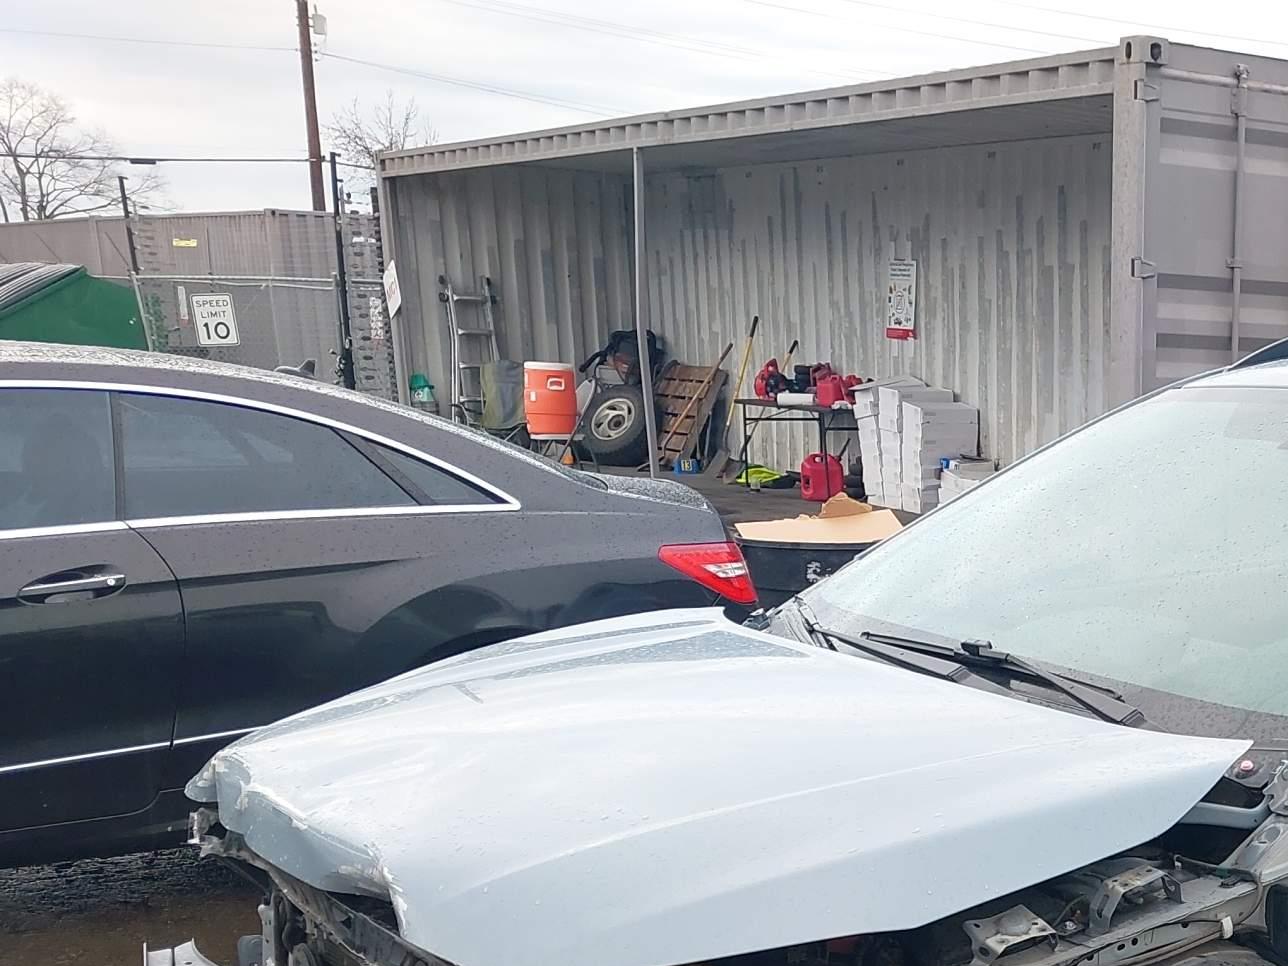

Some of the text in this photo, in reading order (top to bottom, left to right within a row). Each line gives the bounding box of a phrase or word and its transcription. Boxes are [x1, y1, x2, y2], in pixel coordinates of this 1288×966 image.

[195, 299, 229, 308] SPEED
[200, 310, 227, 319] LIMIT
[203, 321, 230, 340] 10
